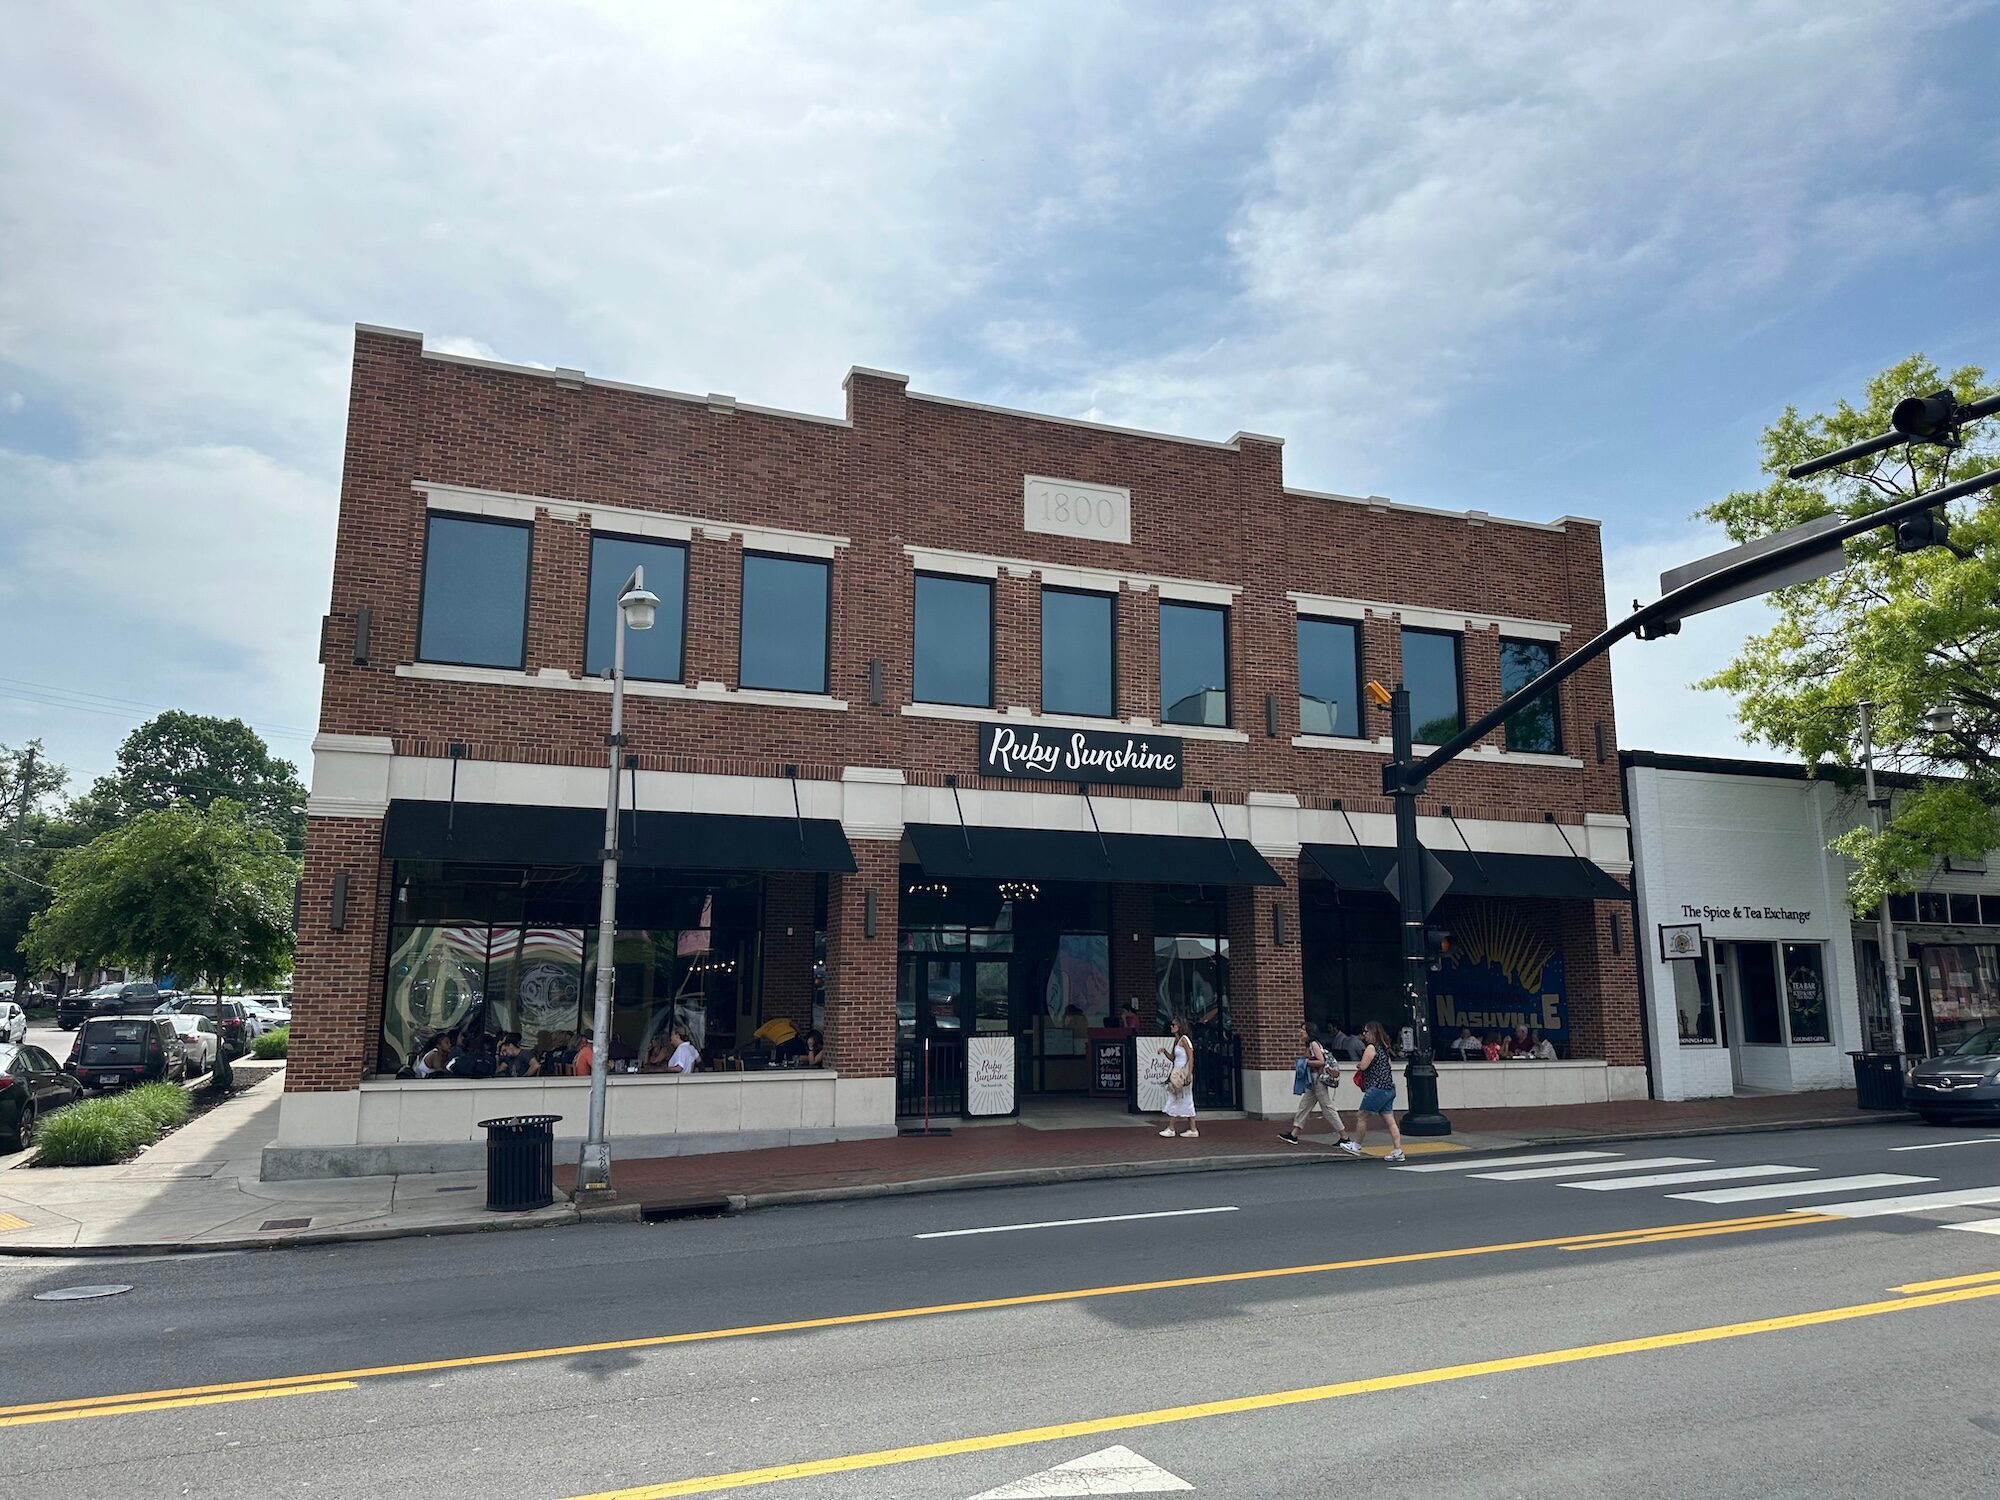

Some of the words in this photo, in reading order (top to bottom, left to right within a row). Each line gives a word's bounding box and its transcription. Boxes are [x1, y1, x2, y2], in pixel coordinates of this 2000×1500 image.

[1041, 491, 1114, 529] 1800
[989, 727, 1060, 773] Ruby
[1065, 732, 1176, 773] Sunshine
[1681, 904, 1701, 918] The
[1703, 905, 1730, 922] Spice
[1732, 906, 1742, 919] &
[1743, 906, 1762, 919] Tea
[1763, 907, 1811, 924] Exchange
[1792, 982, 1803, 990] TEA
[1804, 982, 1816, 990] BAR
[1435, 993, 1562, 1030] NASHVILLE
[1100, 1046, 1121, 1057] LOVE
[981, 1059, 1002, 1074] Ruby
[1150, 1058, 1172, 1071] Ruby
[974, 1070, 1008, 1083] Sunshine
